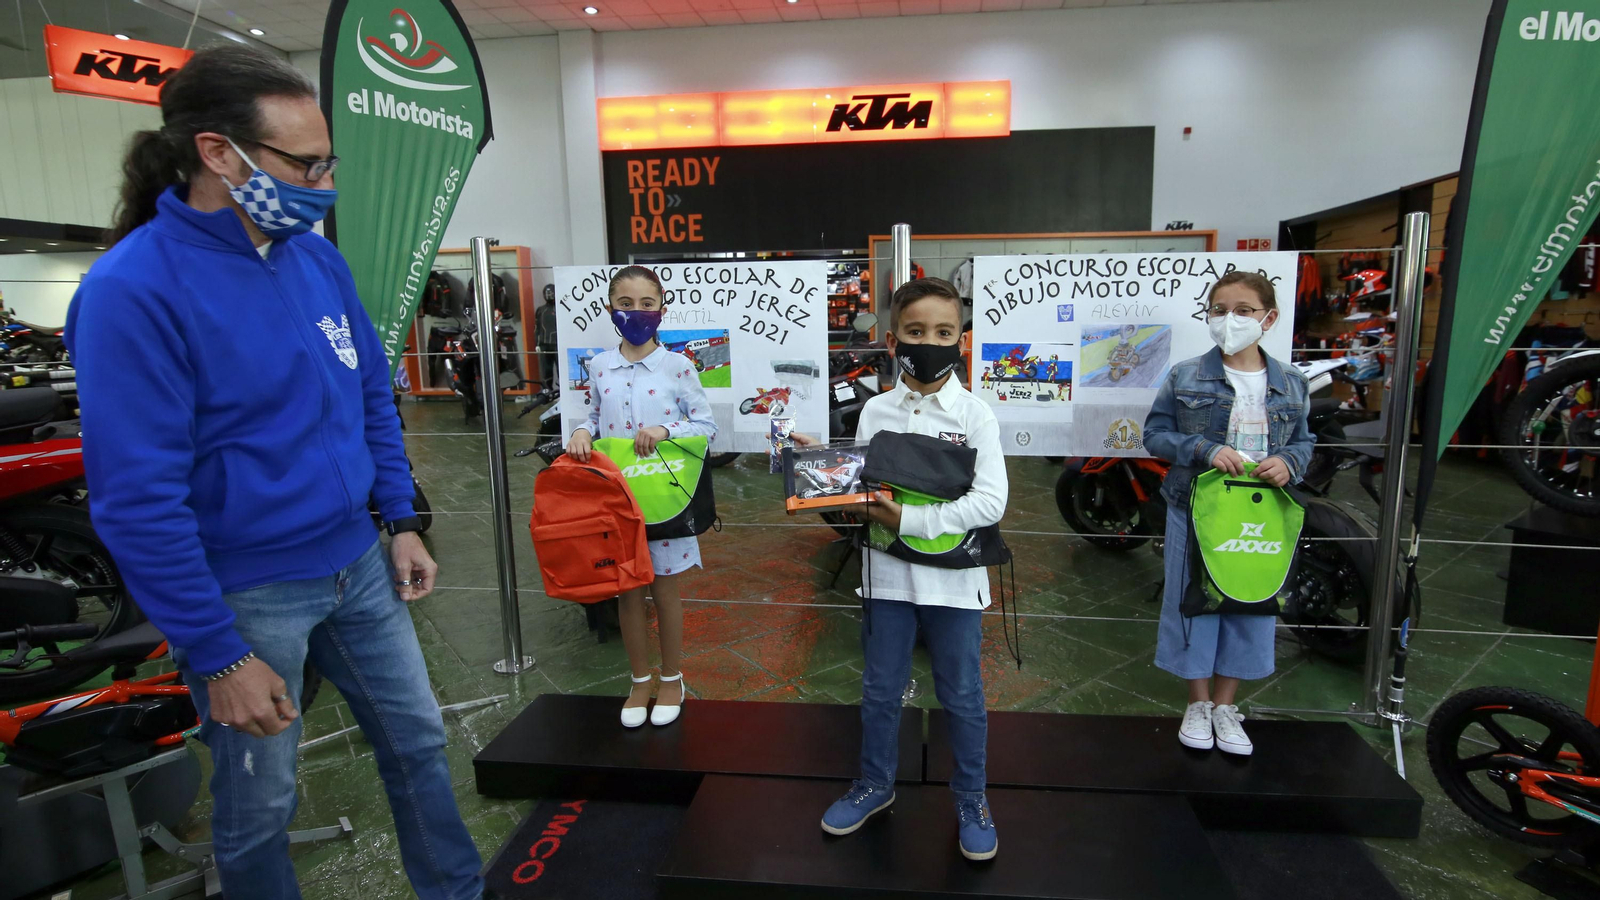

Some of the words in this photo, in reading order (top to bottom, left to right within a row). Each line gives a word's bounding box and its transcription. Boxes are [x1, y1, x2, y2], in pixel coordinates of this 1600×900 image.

[1519, 11, 1548, 40] el
[347, 89, 370, 116] el
[374, 93, 474, 140] Motorista
[825, 93, 933, 132] KTM
[627, 156, 720, 188] READY
[629, 188, 666, 216] TO
[631, 213, 703, 243] RACE
[1165, 220, 1194, 231] KTM
[571, 266, 672, 301] CONCSO
[683, 266, 781, 289] ESCOLAR
[789, 277, 819, 304] DE
[1004, 257, 1128, 287] CONCURSO
[663, 289, 702, 305] OTO
[713, 289, 737, 307] GP
[745, 290, 811, 328] JEREZ
[985, 282, 1060, 327] DIBUJO
[1071, 280, 1140, 299] MOTO
[1153, 278, 1181, 298] GP
[739, 315, 789, 346] 2021
[621, 458, 686, 478] AXXIS
[794, 459, 827, 470] 450/15
[1213, 538, 1282, 555] AXXIS
